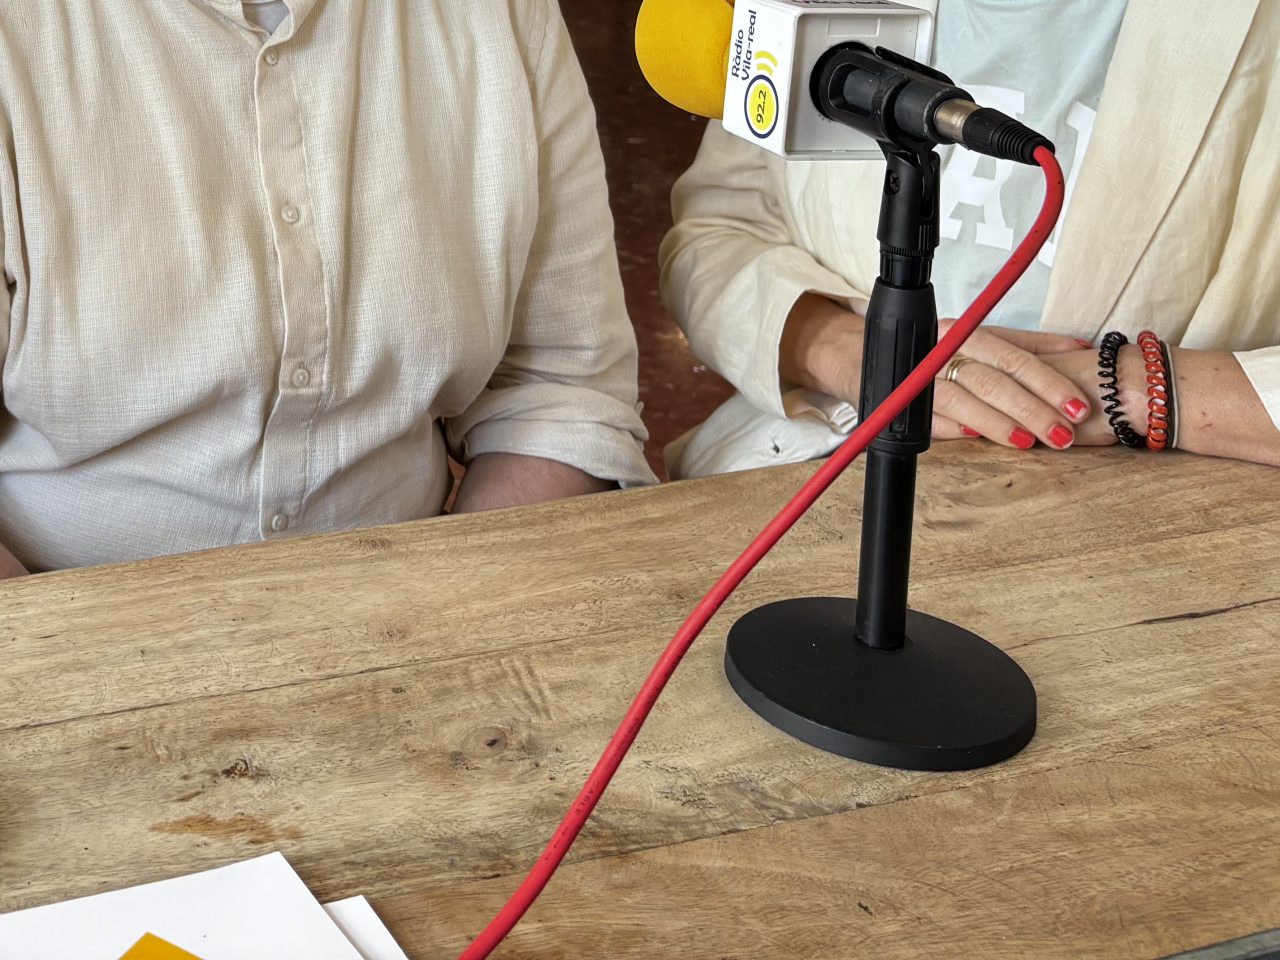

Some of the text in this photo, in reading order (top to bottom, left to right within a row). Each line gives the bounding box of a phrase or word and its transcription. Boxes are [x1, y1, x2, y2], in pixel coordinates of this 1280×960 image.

[731, 28, 745, 79] Ràdio
[741, 9, 758, 81] Vila-real
[755, 89, 767, 124] 92.2
